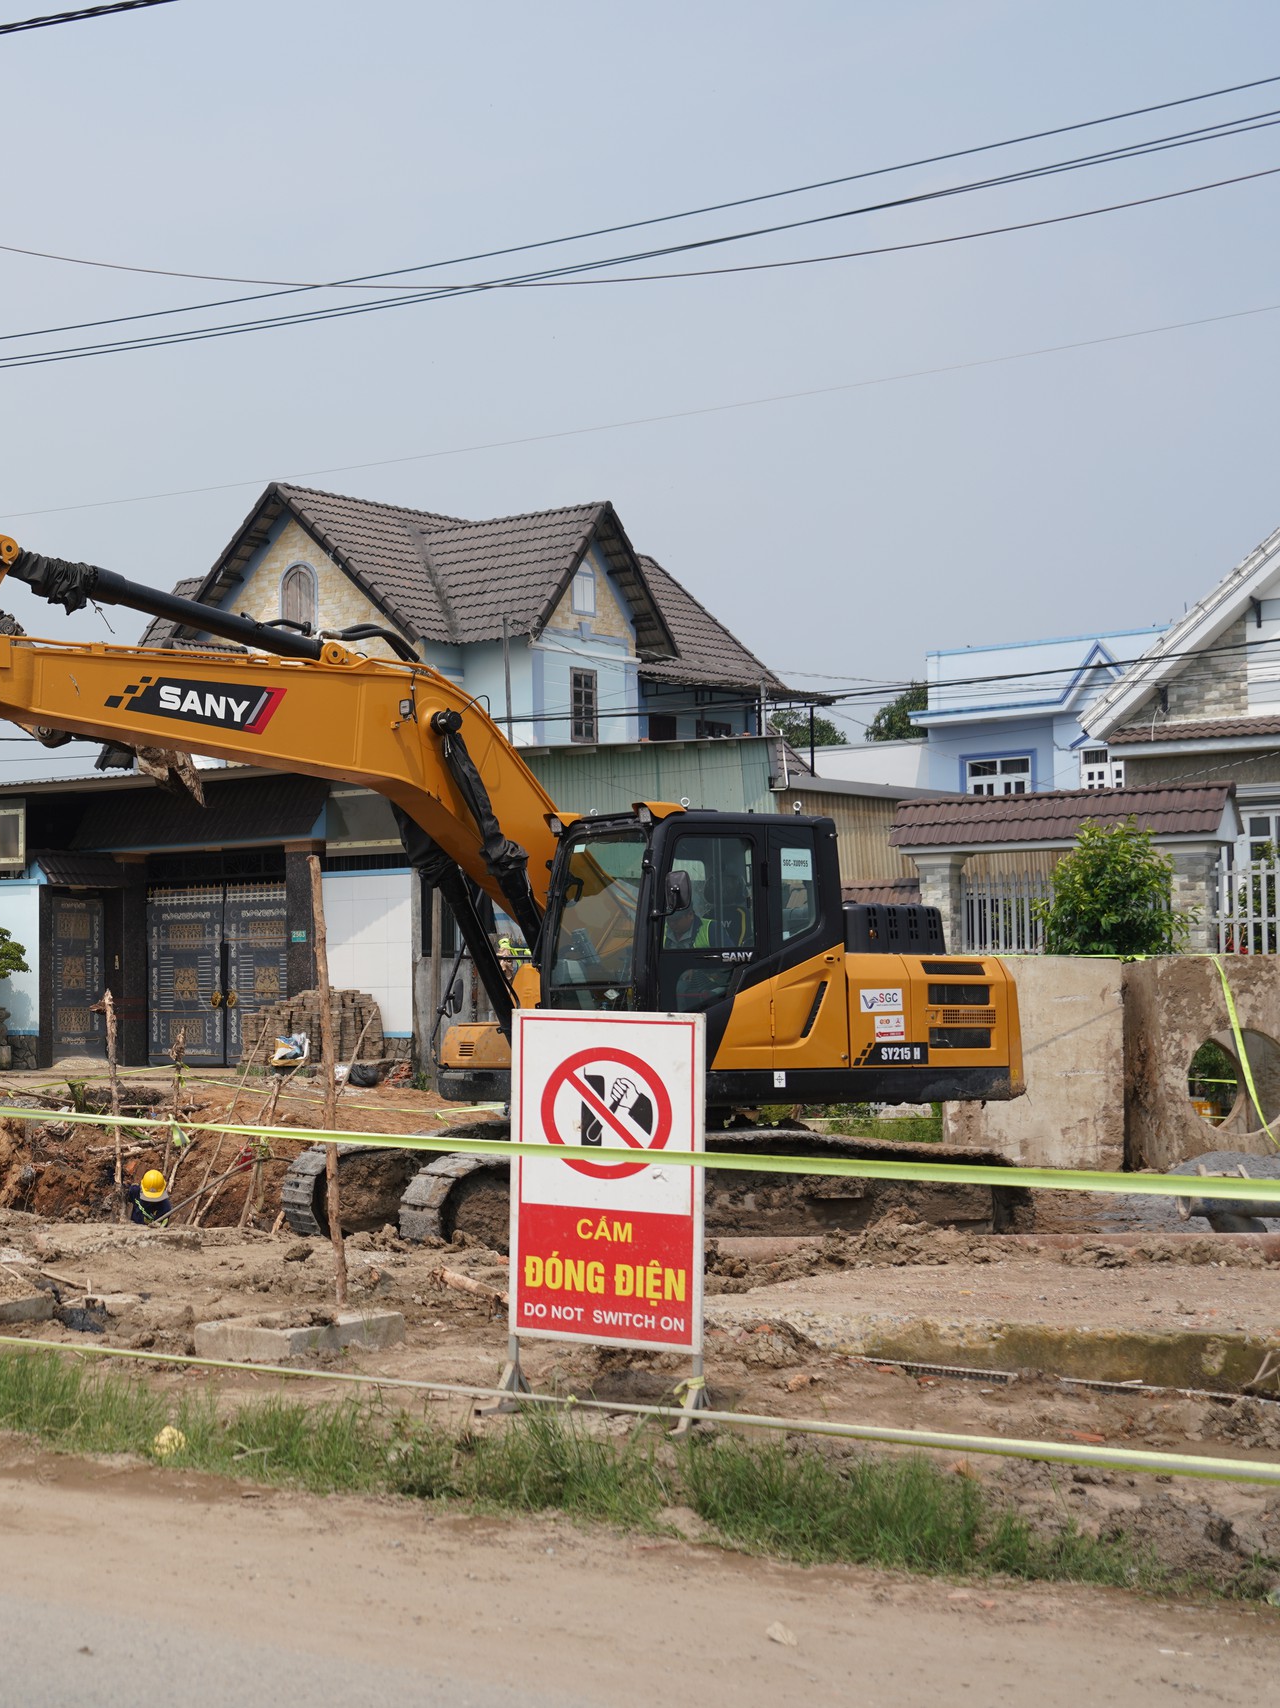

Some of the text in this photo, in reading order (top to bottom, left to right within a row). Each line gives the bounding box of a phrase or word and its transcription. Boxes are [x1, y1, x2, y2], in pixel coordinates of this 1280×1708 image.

[159, 685, 251, 723] SANY
[722, 952, 753, 962] SANY
[879, 993, 898, 1003] SGC
[881, 1047, 920, 1060] SY215 H
[576, 1216, 632, 1243] CẤM
[524, 1251, 686, 1306] ĐÓNG ĐIỆN
[524, 1302, 685, 1332] DO NOT SWITCH ON
